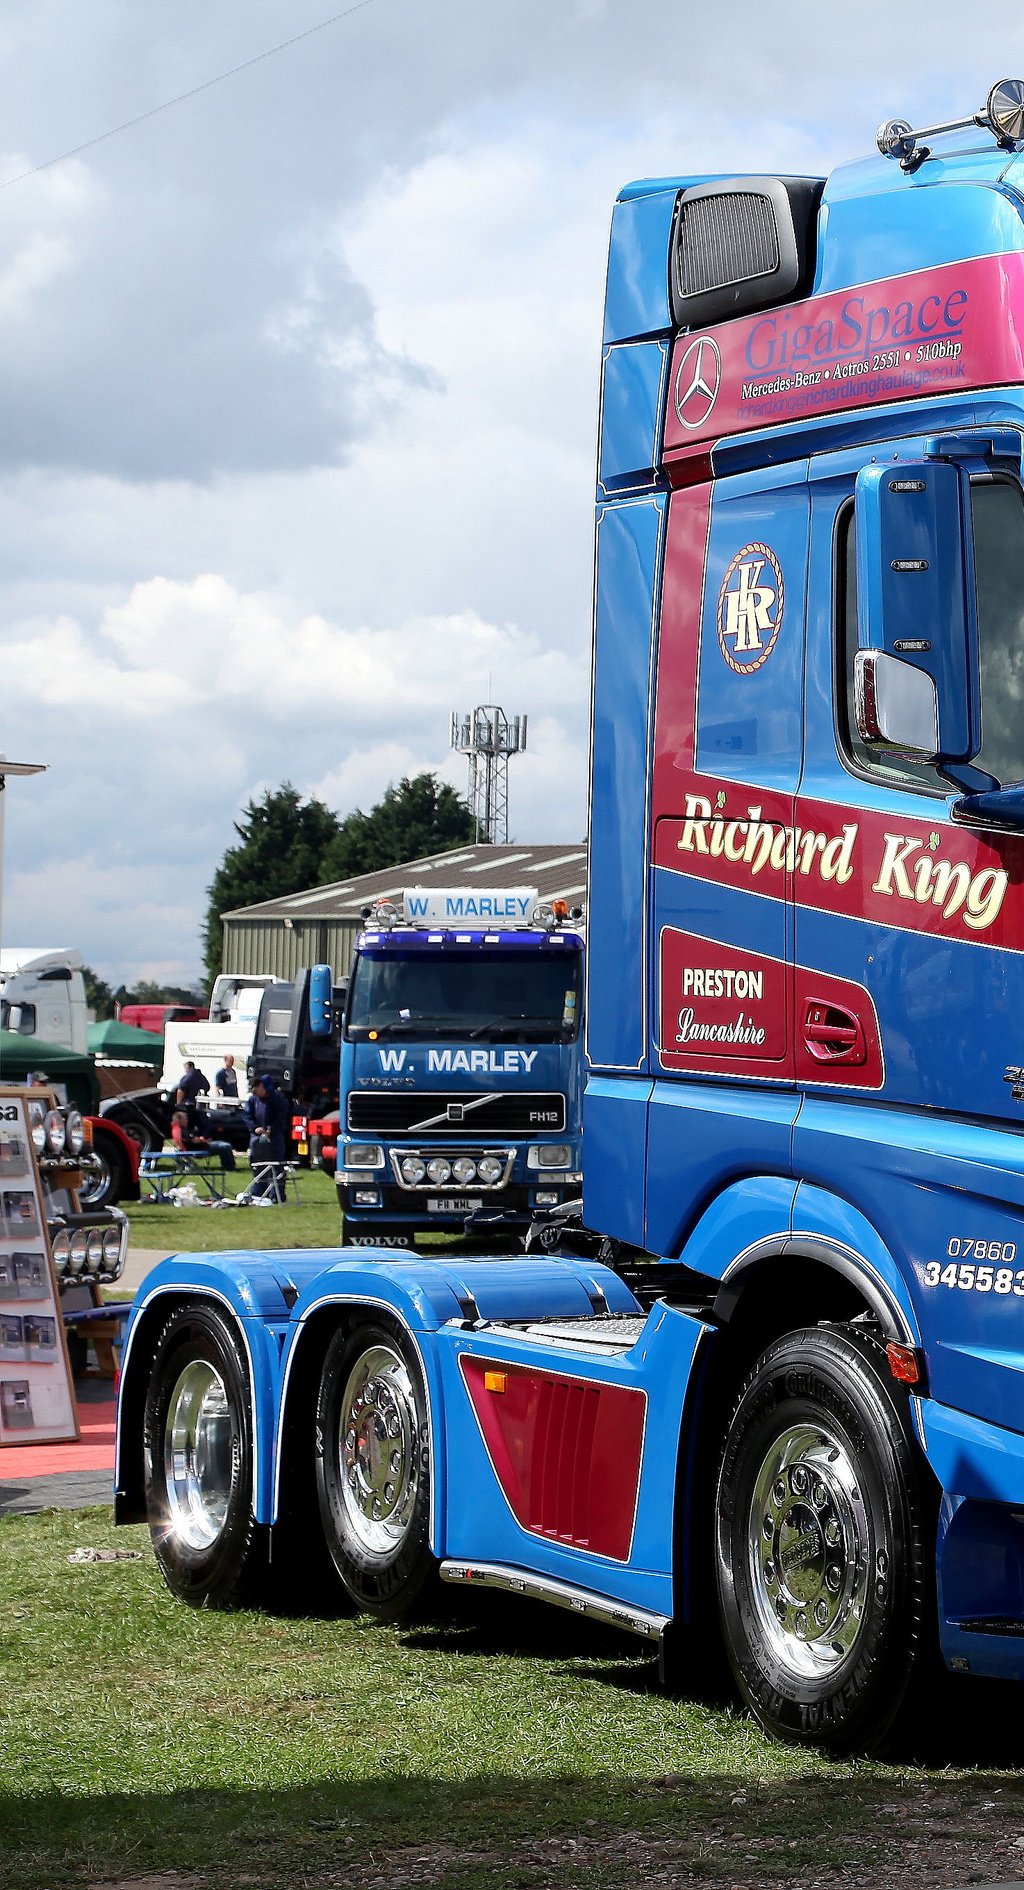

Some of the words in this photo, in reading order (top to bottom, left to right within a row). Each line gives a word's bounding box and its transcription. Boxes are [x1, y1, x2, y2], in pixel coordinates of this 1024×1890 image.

[744, 289, 968, 376] GigaSpace
[741, 371, 822, 400] Mercedes-Benz
[832, 361, 869, 380] Actros
[872, 350, 901, 372] 2551
[915, 339, 962, 363] 510bhp
[677, 793, 859, 885] Richard
[872, 832, 1010, 930] King
[407, 898, 436, 917] W.
[446, 898, 531, 917] MARLEY
[683, 968, 763, 1000] PRESTON
[676, 1007, 767, 1046] Lancashire
[379, 1050, 414, 1072] W.
[427, 1050, 538, 1073] MARLEY
[529, 1112, 558, 1122] FH12
[350, 1236, 409, 1246] VOLVO
[947, 1237, 1017, 1262] 07860
